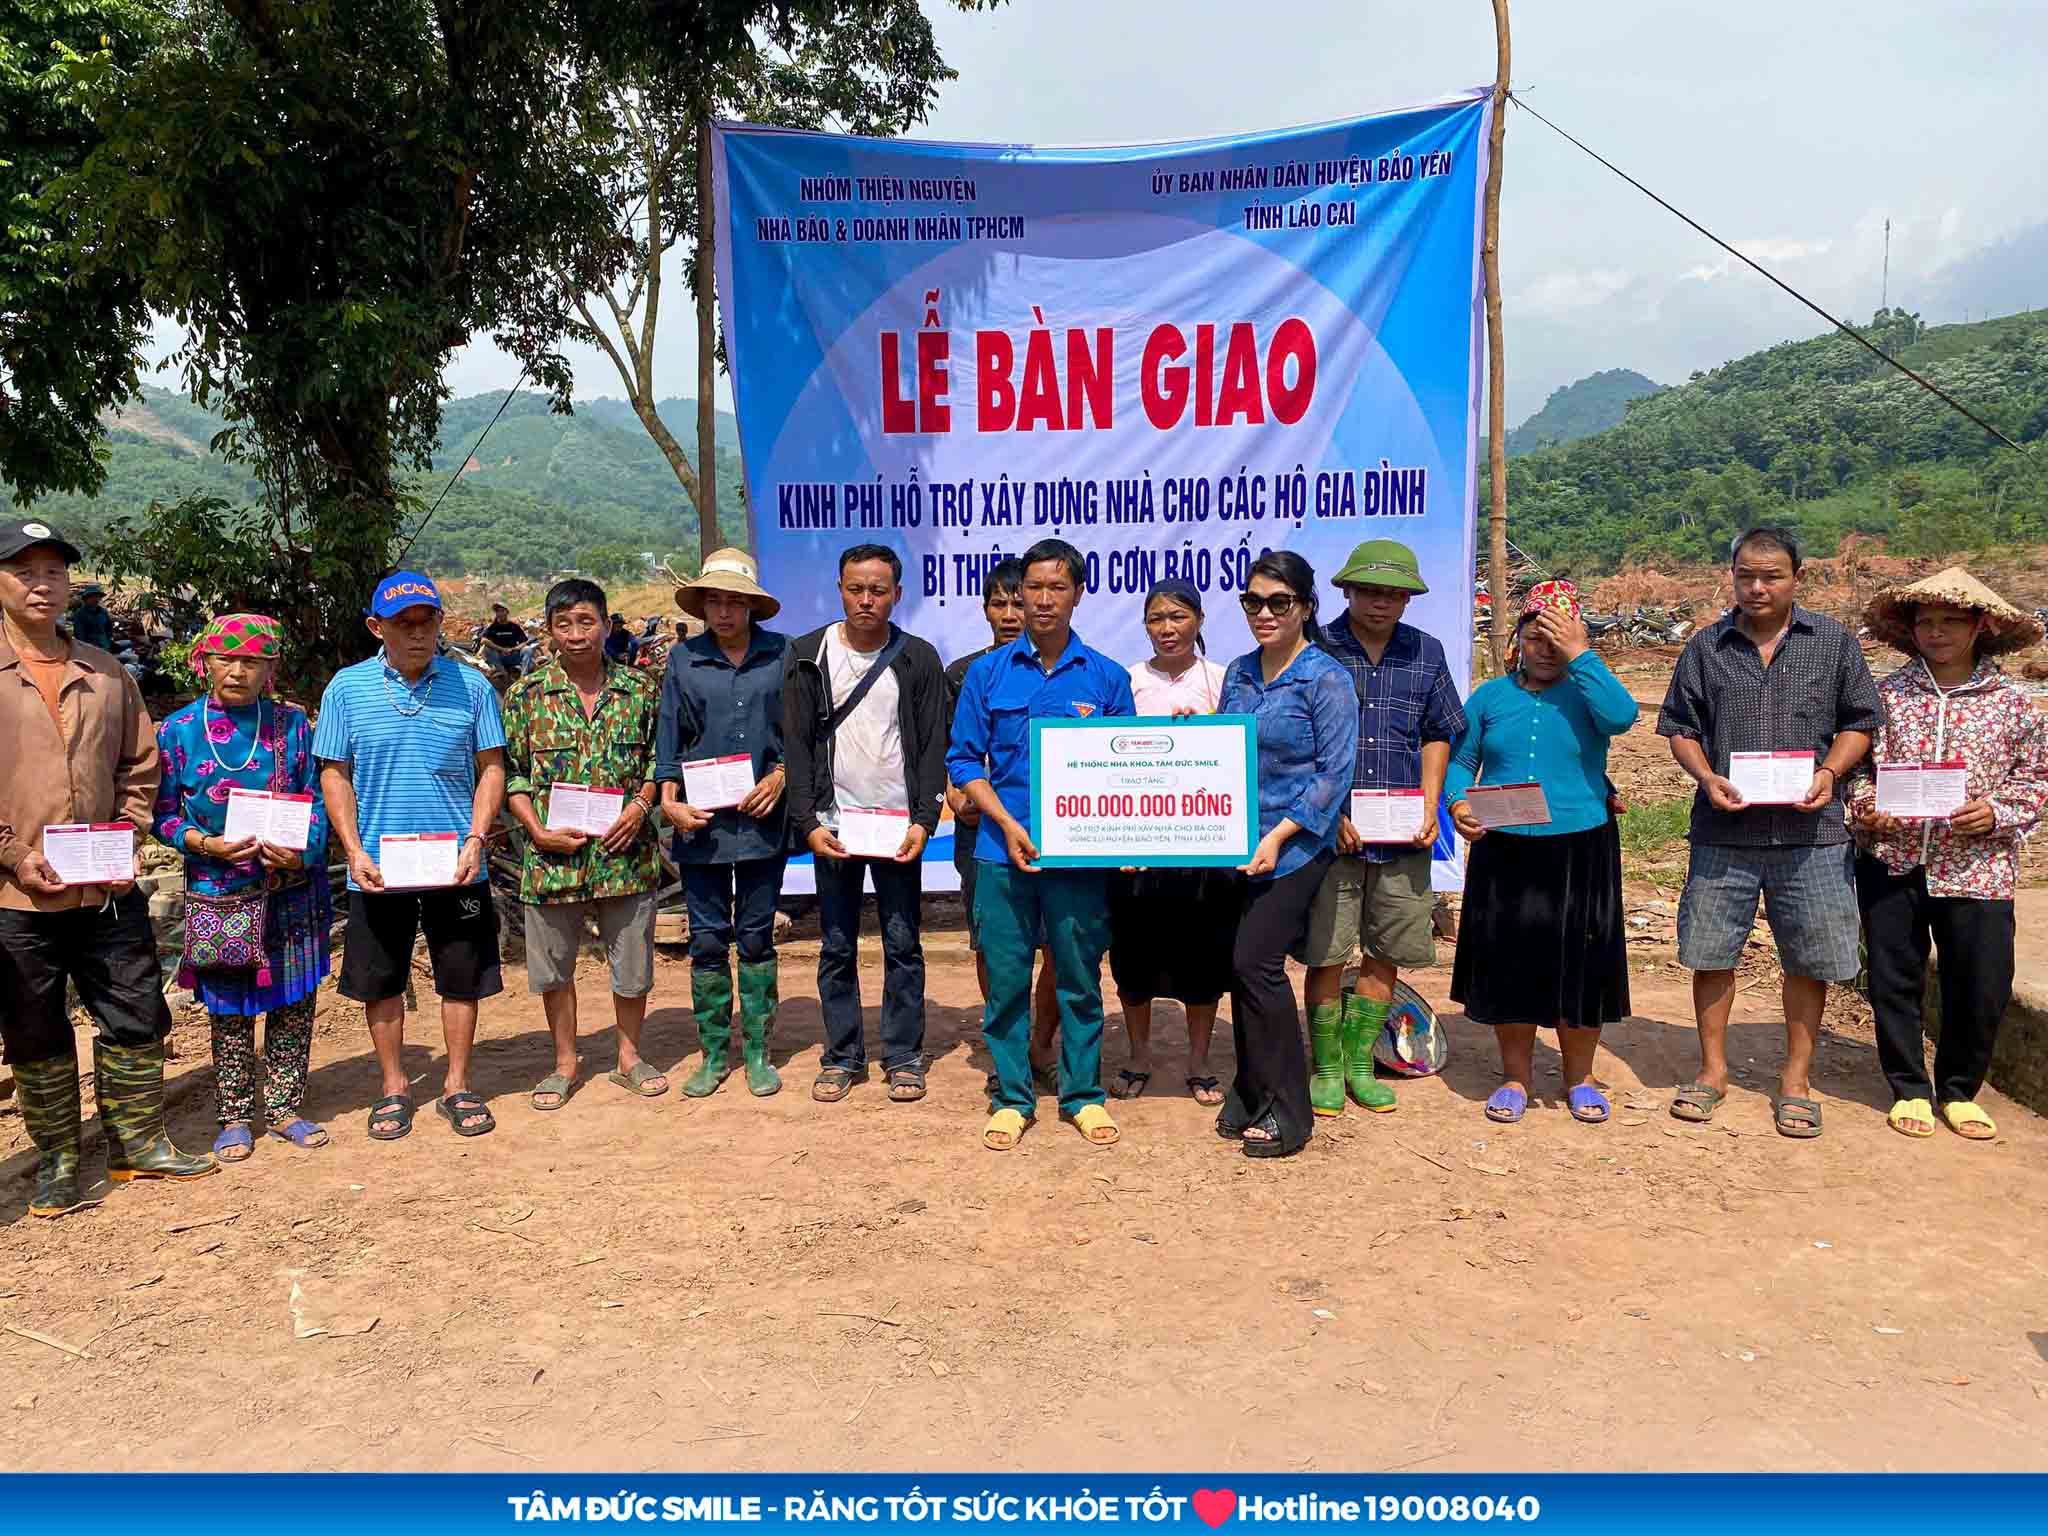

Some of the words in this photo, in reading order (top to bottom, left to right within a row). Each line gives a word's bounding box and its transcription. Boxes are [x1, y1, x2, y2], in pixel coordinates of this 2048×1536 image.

[1152, 167, 1173, 194] ỦY
[1180, 171, 1214, 193] BAN
[1220, 164, 1268, 190] NHÂN
[1315, 154, 1372, 189] HUYỆN
[1378, 148, 1412, 182] BẢO
[1419, 149, 1452, 178] YÊN
[801, 172, 850, 200] NHÓM
[856, 173, 904, 206] THIỆN
[910, 175, 976, 206] NGUYỆN
[758, 215, 791, 240] NHÀ
[797, 211, 829, 241] BÁO
[836, 221, 848, 241] &
[854, 218, 908, 241] DOANH
[915, 212, 961, 240] NHÂN
[966, 216, 1024, 239] TPHCM
[1244, 199, 1283, 230] TỈNH
[1288, 197, 1321, 227] LÀO
[1327, 201, 1356, 226] CAI
[880, 288, 951, 433] LỄ
[976, 306, 1113, 432] BÀN
[1140, 318, 1317, 431] GIAO
[779, 484, 836, 528] KINH
[845, 473, 883, 528] PHÍ
[891, 466, 921, 528] HỖ
[929, 478, 973, 536] TRỢ
[981, 473, 1025, 527] XÂY
[1034, 477, 1097, 535] DỰNG
[1107, 469, 1154, 524] NHÀ
[1163, 477, 1209, 522] CHO
[1218, 466, 1266, 521] CÁC
[1275, 464, 1306, 528] HỘ
[1315, 471, 1356, 517] GIA
[1364, 460, 1425, 516] ĐÌNH
[923, 554, 945, 606] BỊ
[1109, 545, 1156, 594] CƠN
[1165, 539, 1210, 592] BÃO
[1220, 531, 1252, 592] SỐ
[1194, 759, 1219, 767] SMILE
[1056, 794, 1176, 818] 600.000.000
[1182, 787, 1232, 817] ĐỒNG
